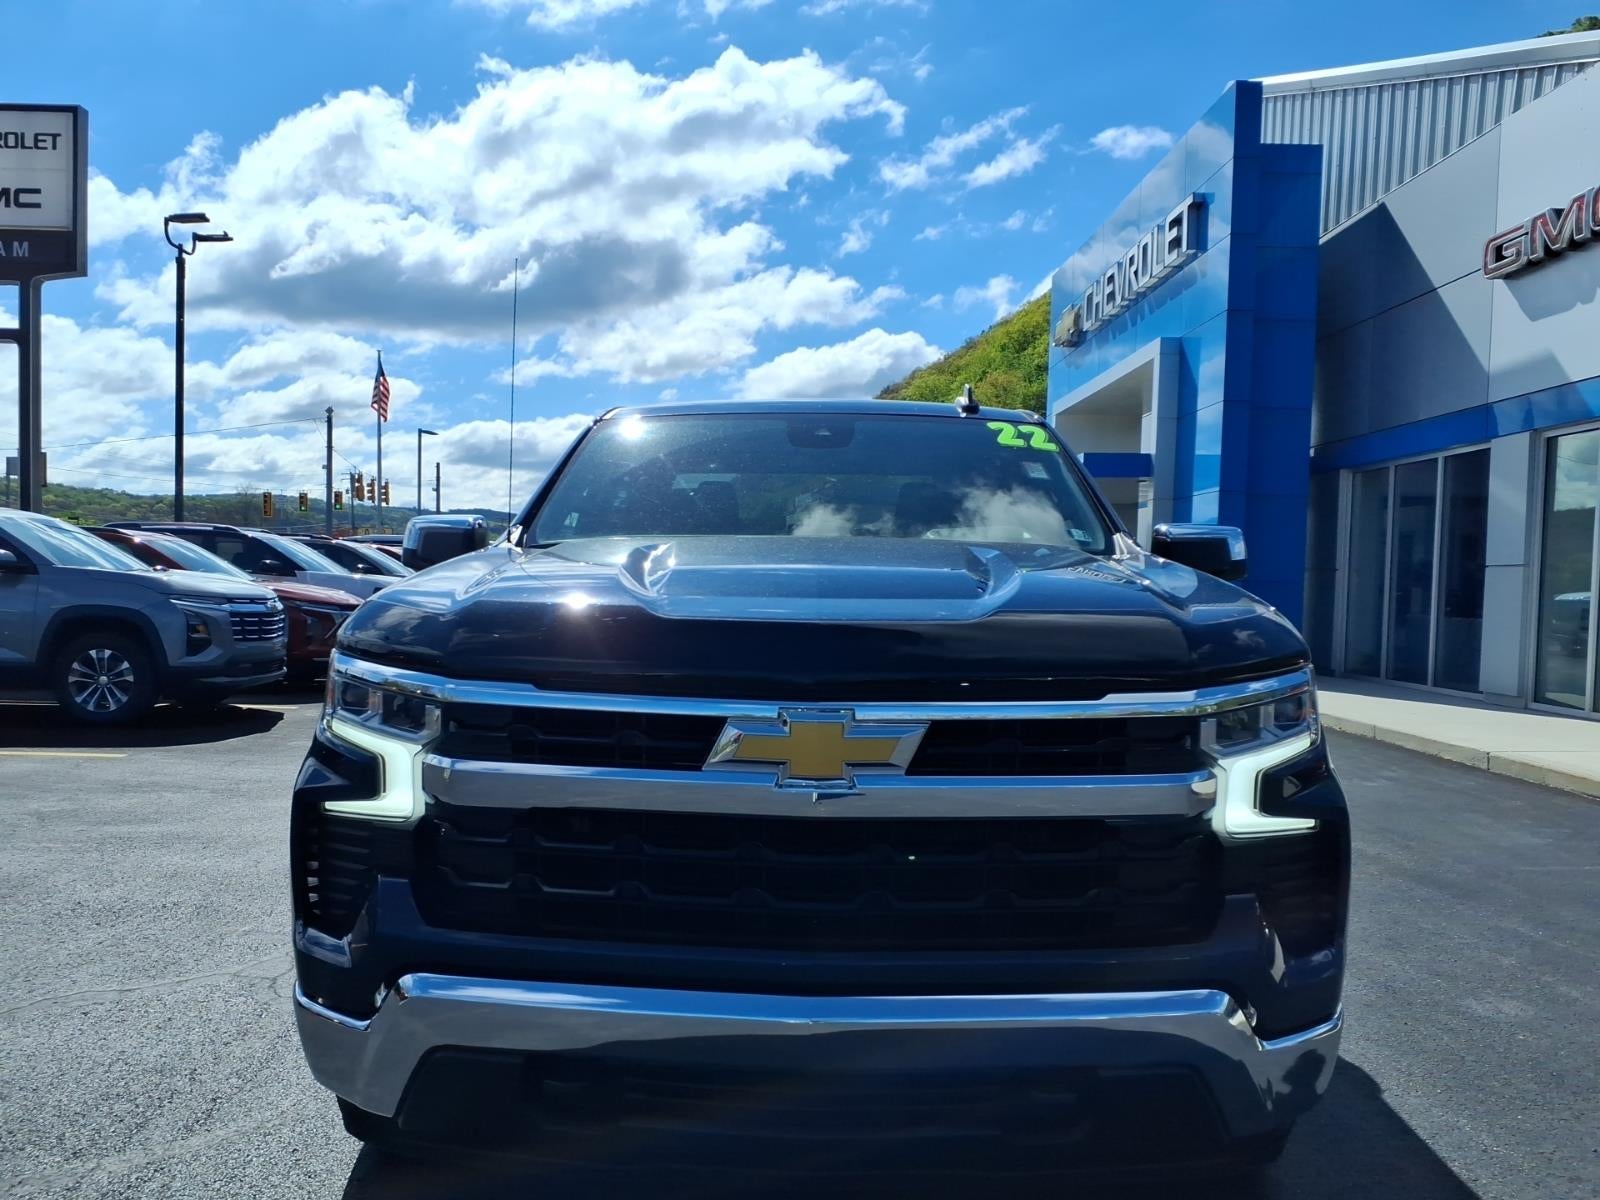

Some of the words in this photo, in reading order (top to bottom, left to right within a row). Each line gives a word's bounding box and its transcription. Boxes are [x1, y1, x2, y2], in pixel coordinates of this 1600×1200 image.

[0, 131, 62, 151] OLET
[1082, 192, 1196, 332] CHEVROLET
[1483, 184, 1600, 280] GM
[986, 421, 1060, 453] 22
